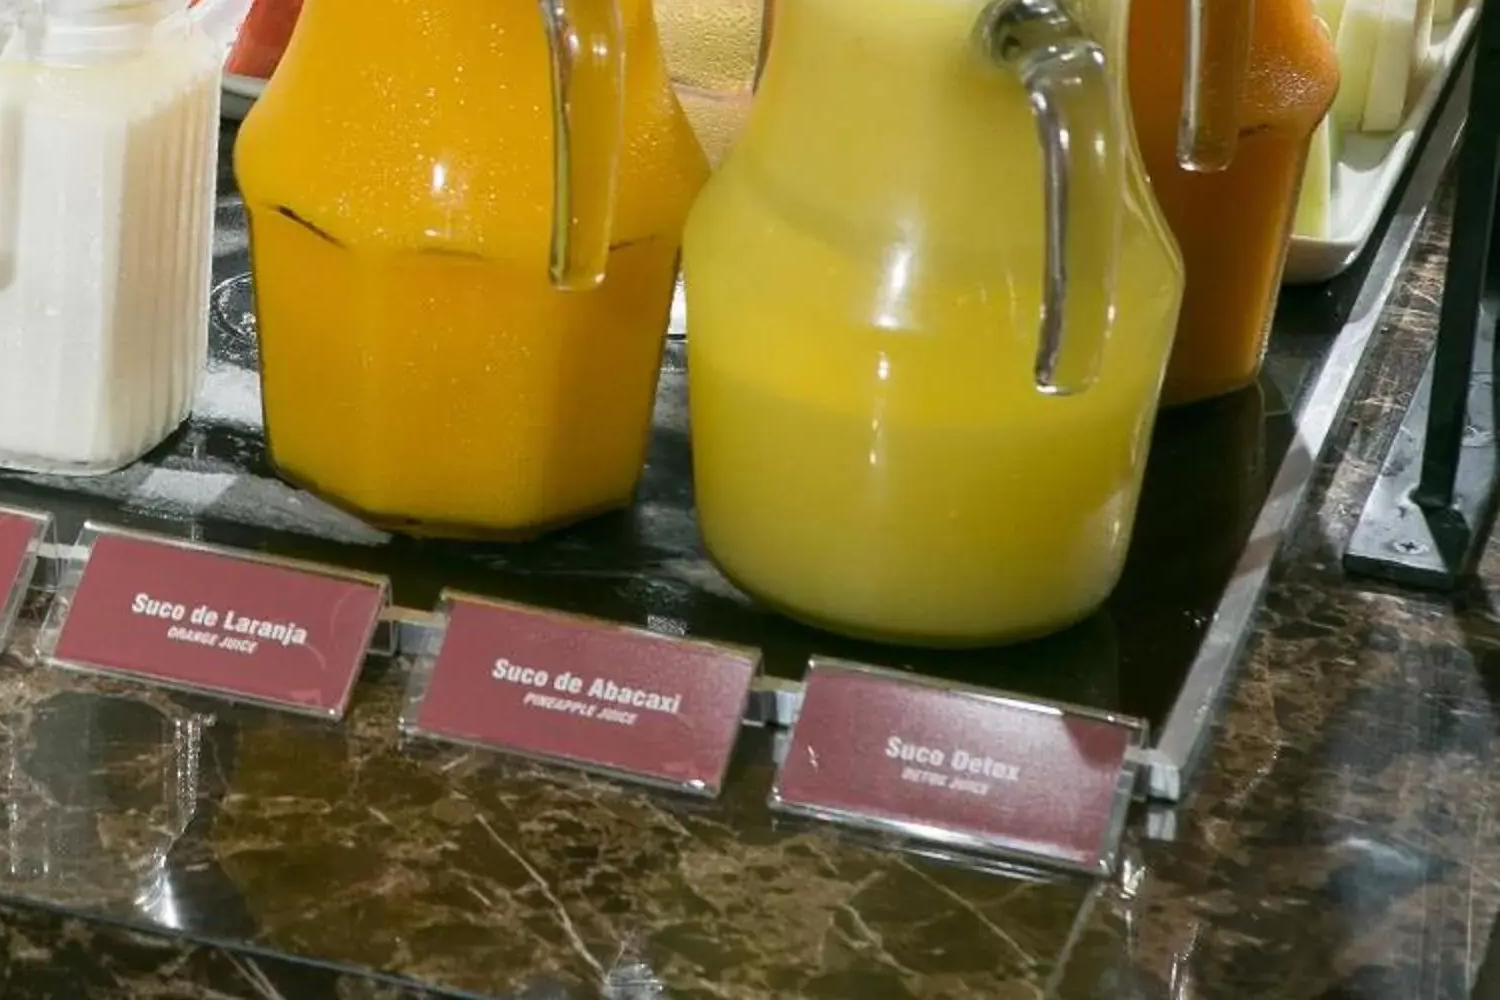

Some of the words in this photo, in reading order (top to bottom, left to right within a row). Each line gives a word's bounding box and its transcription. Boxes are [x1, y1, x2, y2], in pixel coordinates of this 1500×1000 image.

[132, 593, 186, 621] Suco
[190, 605, 219, 627] de
[223, 610, 307, 646] Laranja
[167, 625, 219, 646] ORANGE
[218, 637, 258, 654] JUICE
[492, 658, 548, 686] Suco
[554, 671, 583, 694] de
[587, 678, 683, 714] Abacaxi
[522, 691, 597, 717] PINEAPPLE
[596, 706, 639, 725] JUICE
[885, 736, 946, 766] Suco
[951, 750, 1020, 781] Detox
[901, 767, 949, 786] DETOX
[949, 778, 990, 796] JUICE
